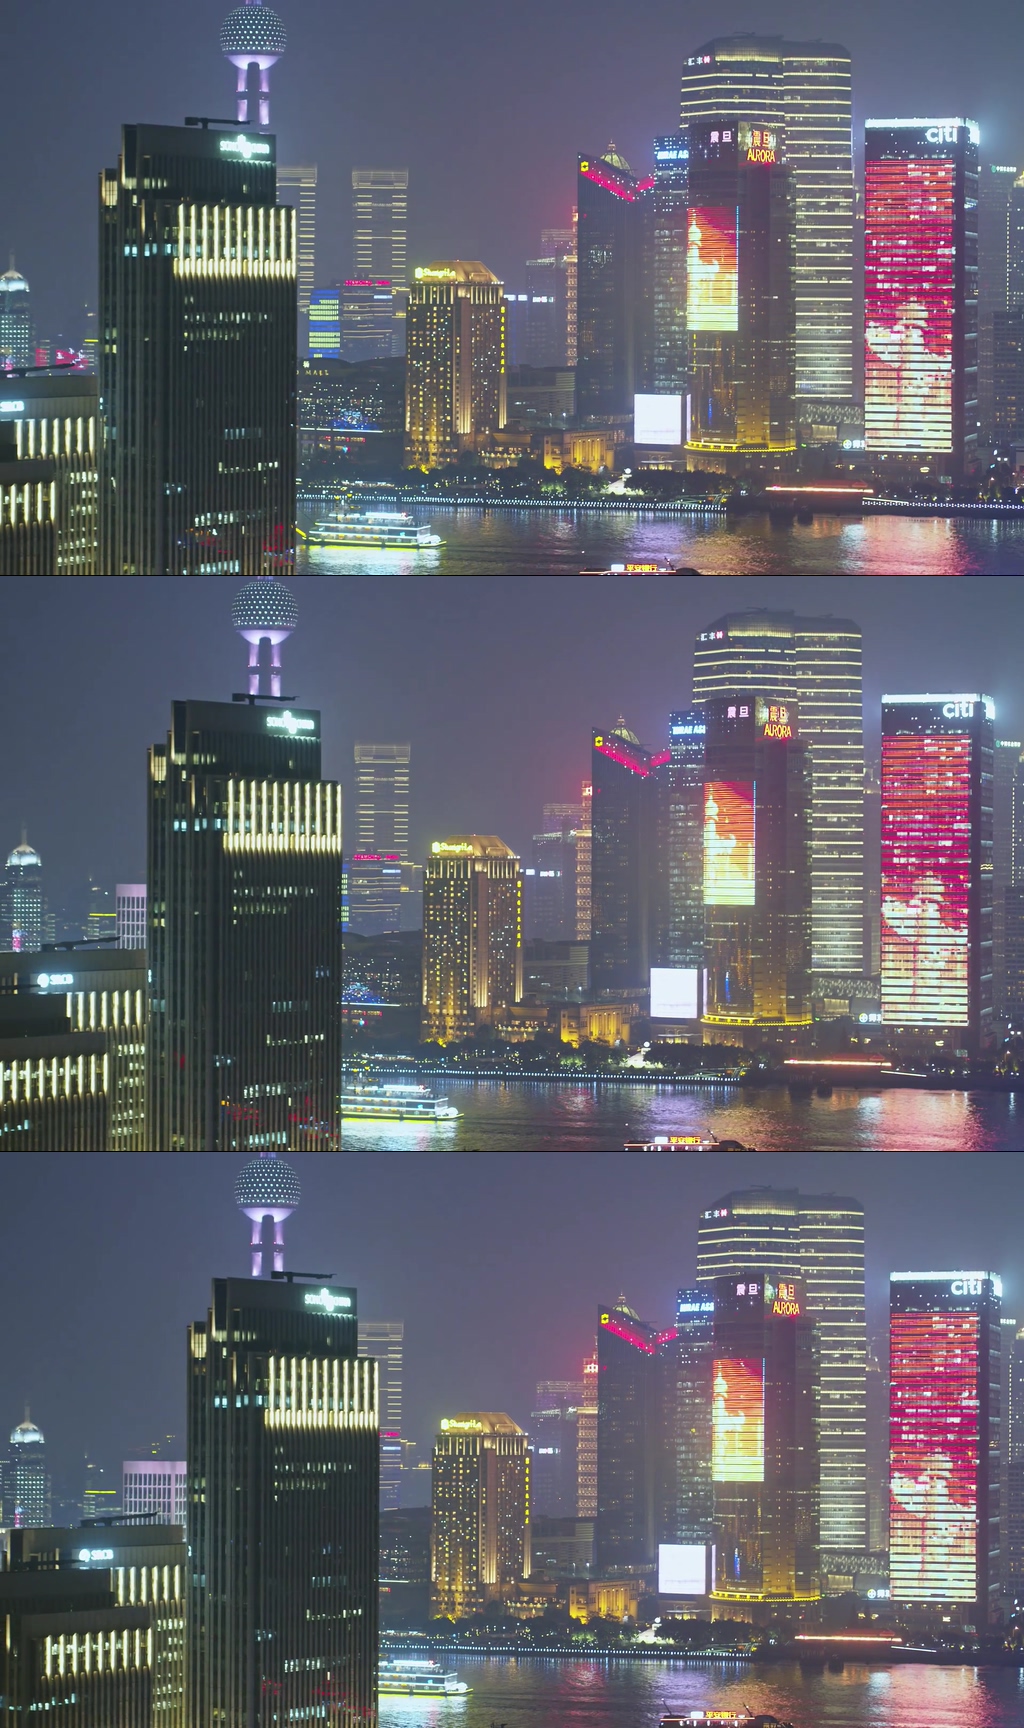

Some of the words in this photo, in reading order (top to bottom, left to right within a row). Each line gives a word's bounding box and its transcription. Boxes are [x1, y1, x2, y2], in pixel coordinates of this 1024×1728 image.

[710, 131, 732, 143] 震旦
[926, 126, 958, 143] citi
[747, 149, 776, 163] AURORA
[727, 706, 749, 719] 震旦
[942, 701, 974, 718] citi
[764, 723, 792, 738] AURORA
[736, 1284, 758, 1296] 震旦
[951, 1279, 982, 1295] citi
[772, 1301, 800, 1315] AURORA
